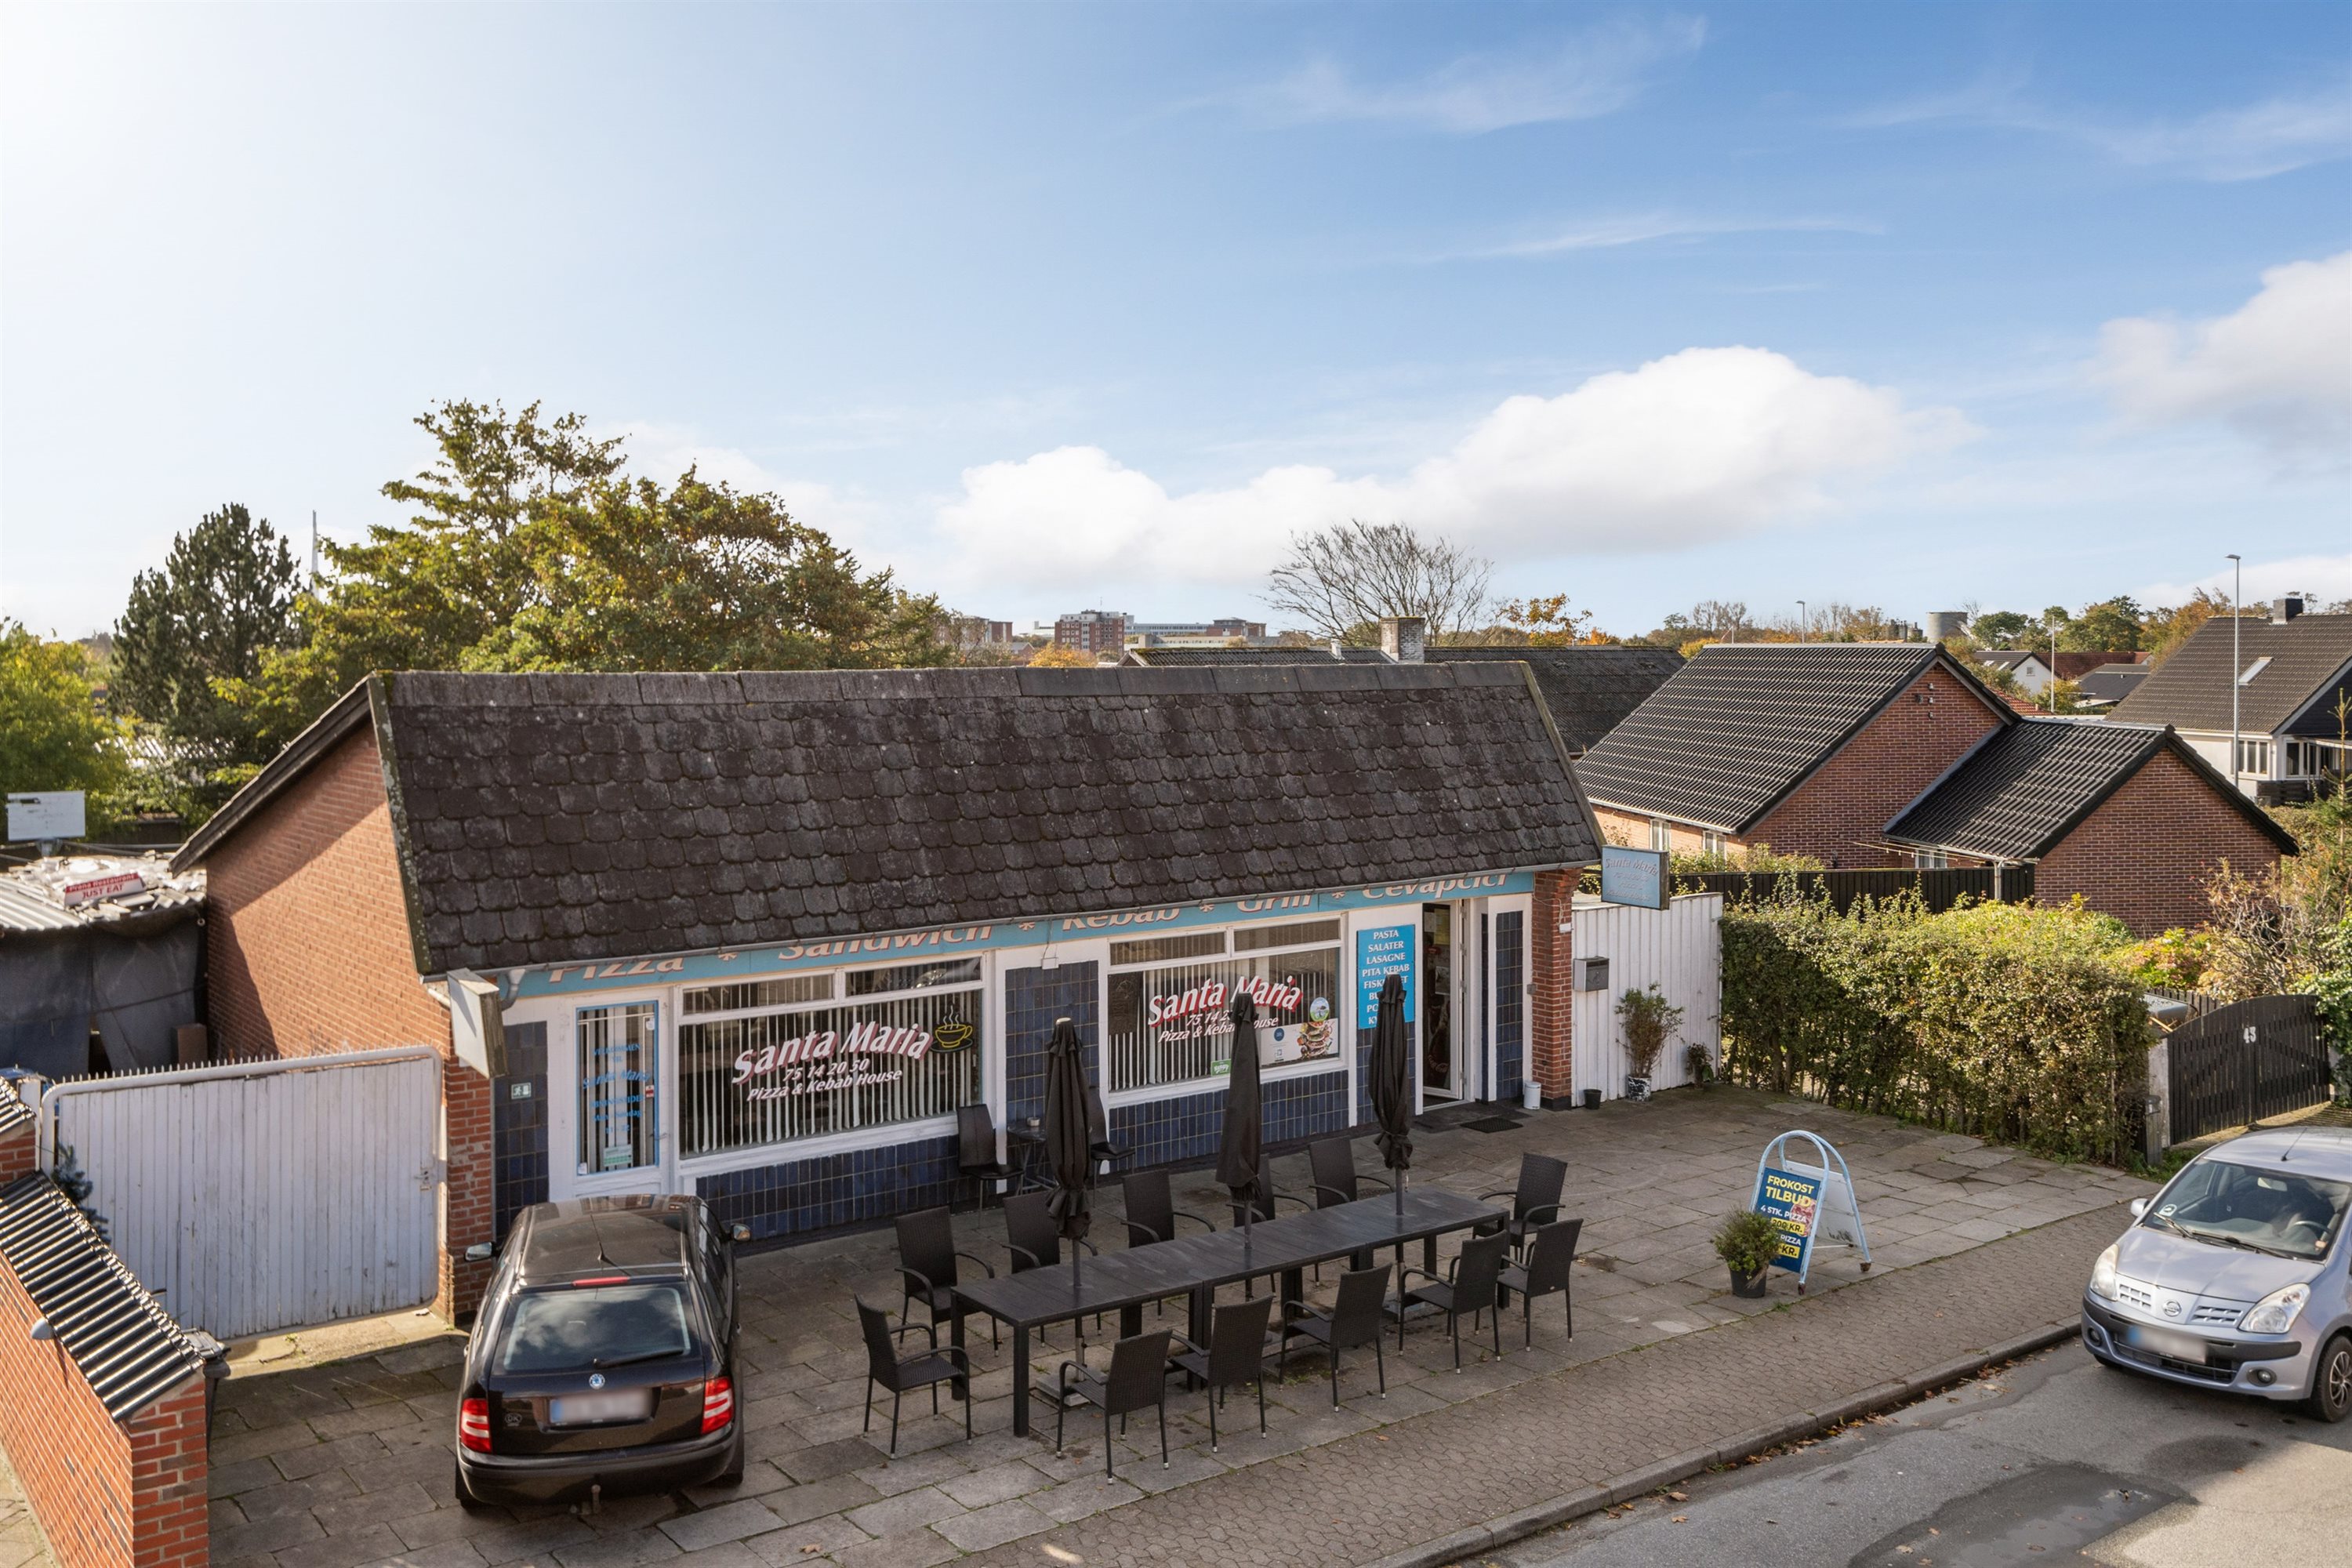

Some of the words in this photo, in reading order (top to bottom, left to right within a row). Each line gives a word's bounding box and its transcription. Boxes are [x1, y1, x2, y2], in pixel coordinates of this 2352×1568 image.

[1606, 856, 1631, 869] Santa
[1633, 859, 1657, 876] Maria
[83, 888, 103, 898] JUST
[107, 884, 124, 894] EAT
[1374, 930, 1399, 940] PASTA
[1368, 941, 1404, 953] SALATER
[1367, 953, 1406, 964] LASAGNE
[1362, 967, 1381, 978] PITA
[1383, 964, 1410, 975] KEBAB
[1147, 978, 1228, 1028] Santa
[1230, 975, 1303, 1013] Maria
[1185, 1014, 1201, 1027] 75
[1204, 1011, 1218, 1025] 14
[1220, 1010, 1232, 1021] 2
[1158, 1029, 1190, 1044] Pizza
[1192, 1025, 1203, 1038] &
[1205, 1022, 1236, 1036] Keba
[1254, 1017, 1279, 1029] ouse
[731, 1029, 839, 1085] Santa
[840, 1021, 933, 1060] Maria
[782, 1067, 804, 1082] 75
[807, 1064, 825, 1079] 14
[827, 1061, 847, 1076] 20
[849, 1058, 871, 1073] 50
[746, 1085, 789, 1102] Pizza
[791, 1083, 804, 1095] &
[806, 1075, 853, 1094] Kebab
[856, 1069, 902, 1087] House
[1767, 1174, 1815, 1195] FROKOST
[1766, 1185, 1812, 1207] TILBUD
[1767, 1206, 1783, 1217] STK.
[1784, 1211, 1808, 1223] PIZZA
[1788, 1223, 1803, 1233] KR.
[1780, 1234, 1802, 1246] PIZZA
[1781, 1245, 1797, 1257] KR.
